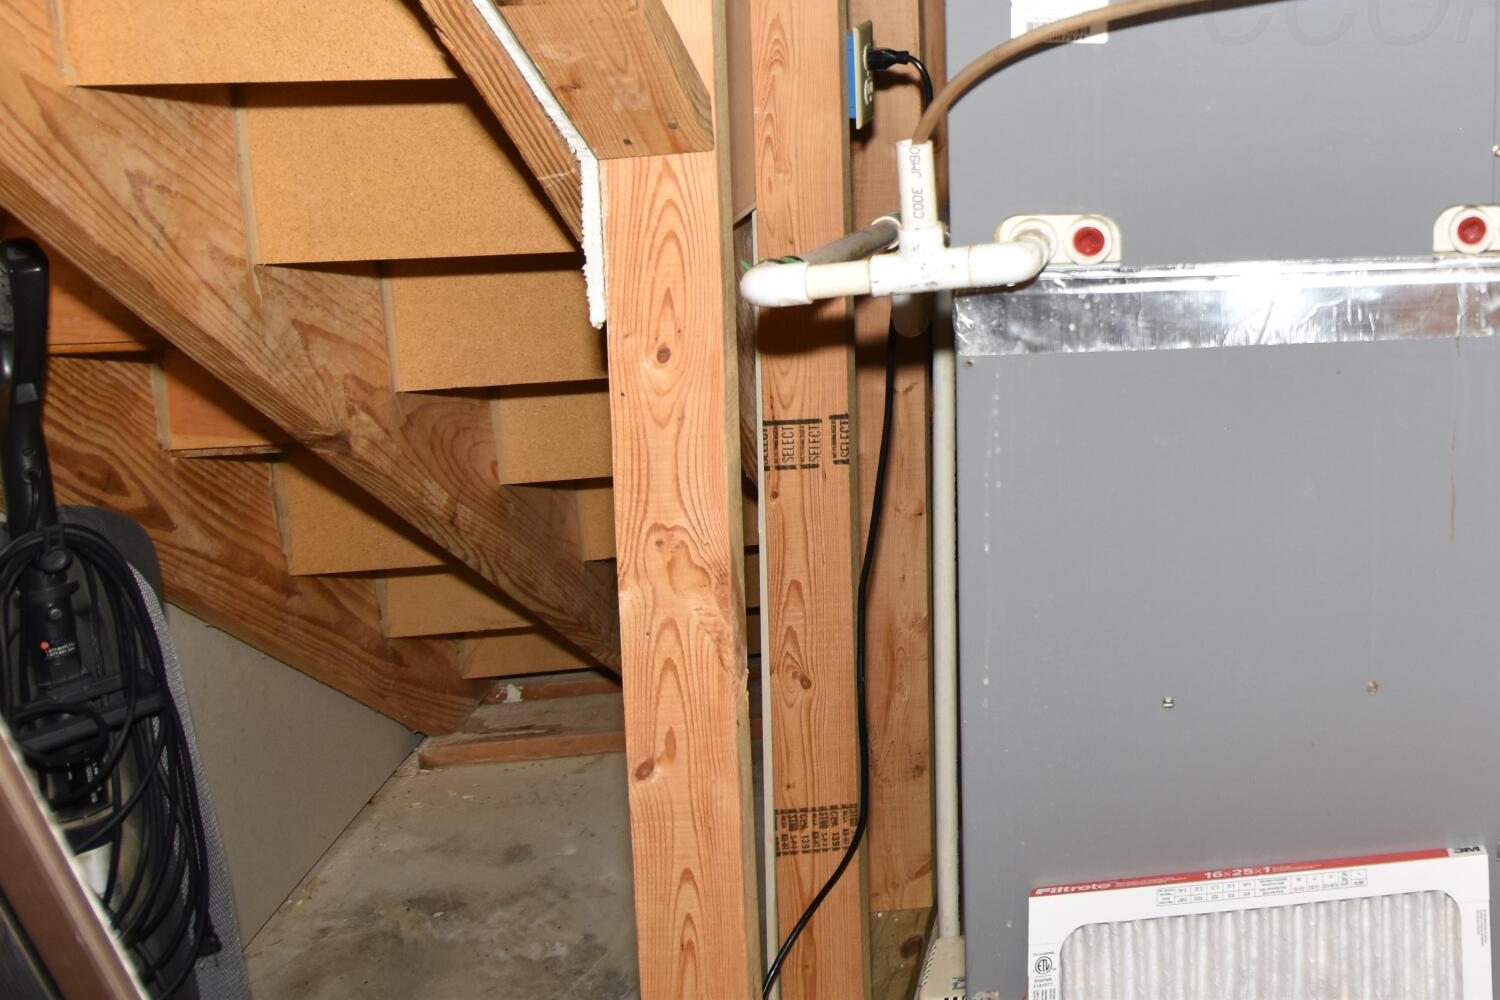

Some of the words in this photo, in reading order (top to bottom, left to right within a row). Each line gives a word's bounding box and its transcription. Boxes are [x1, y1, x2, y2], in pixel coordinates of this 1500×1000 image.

[912, 187, 925, 219] CODE
[782, 424, 795, 463] SELECT
[808, 424, 821, 463] SELECT
